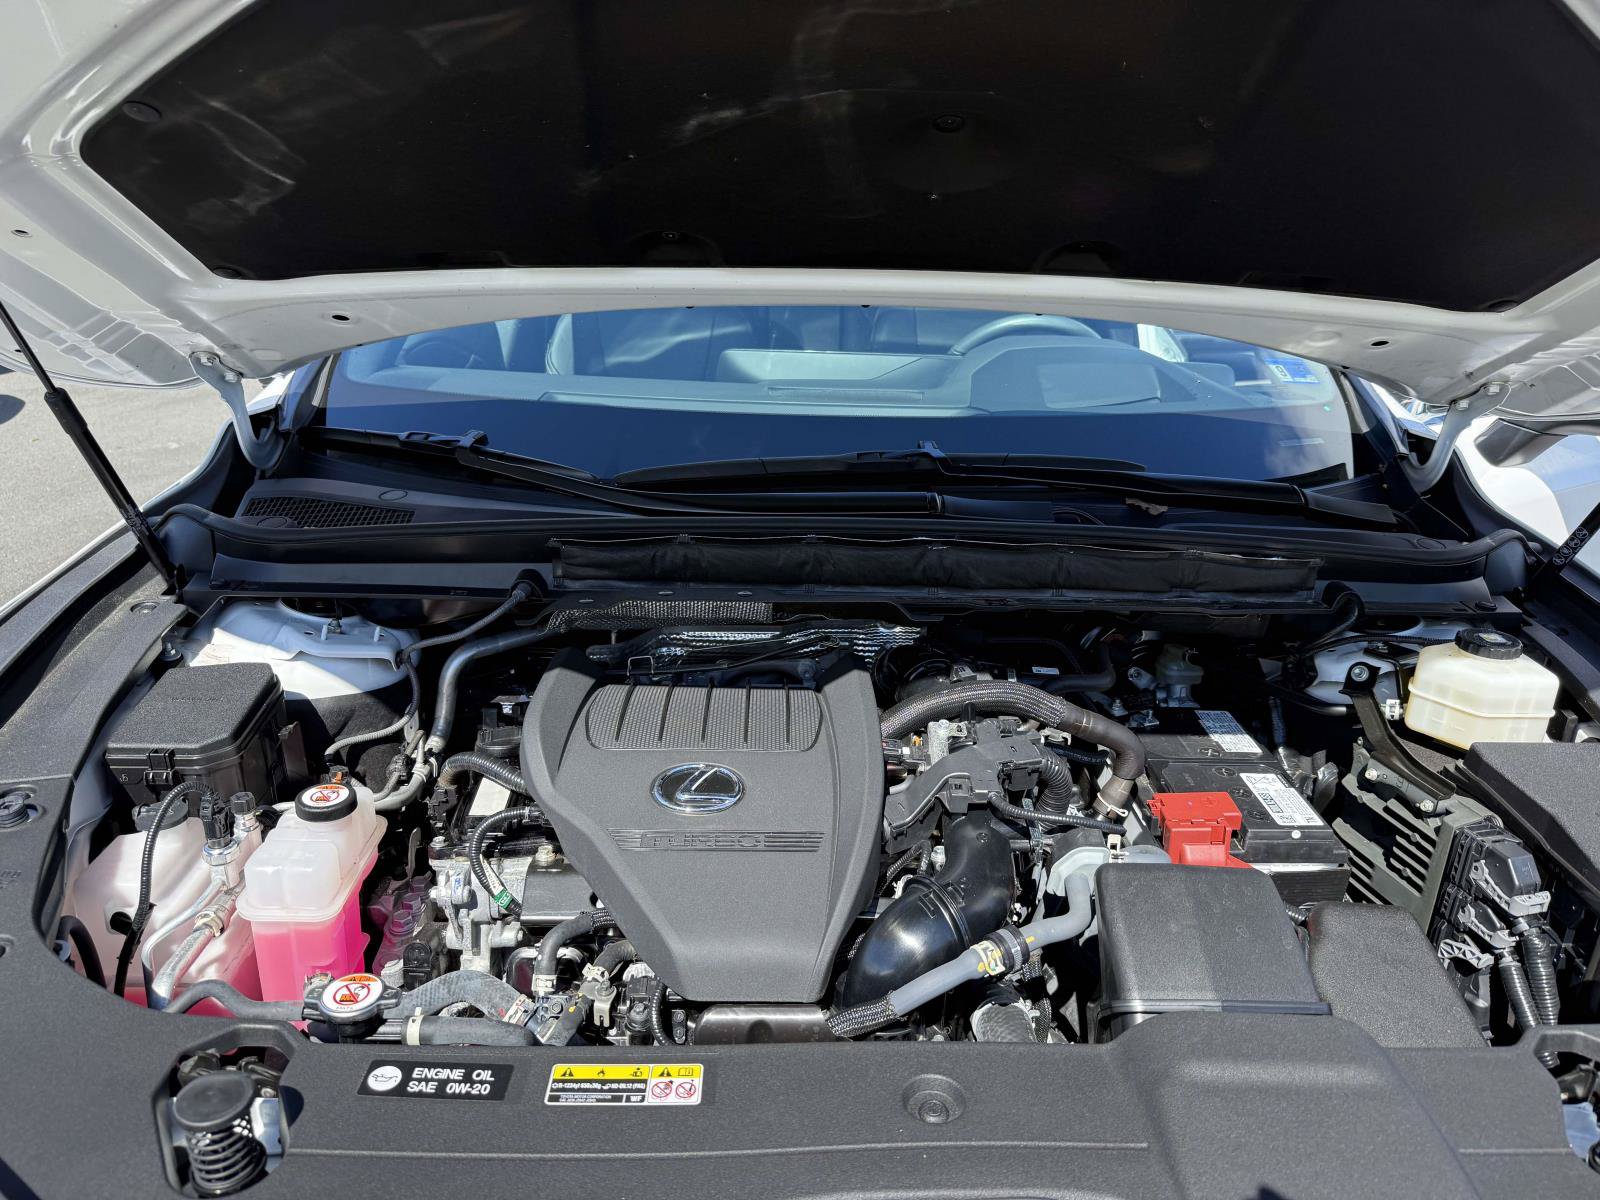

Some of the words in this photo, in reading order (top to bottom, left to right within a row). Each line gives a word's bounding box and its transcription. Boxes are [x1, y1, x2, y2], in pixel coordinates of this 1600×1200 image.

[645, 833, 760, 847] TURBO
[412, 1068, 465, 1079] ENGINE
[472, 1070, 495, 1081] OIL
[407, 1081, 438, 1092] SAE
[446, 1083, 490, 1094] 0W-20
